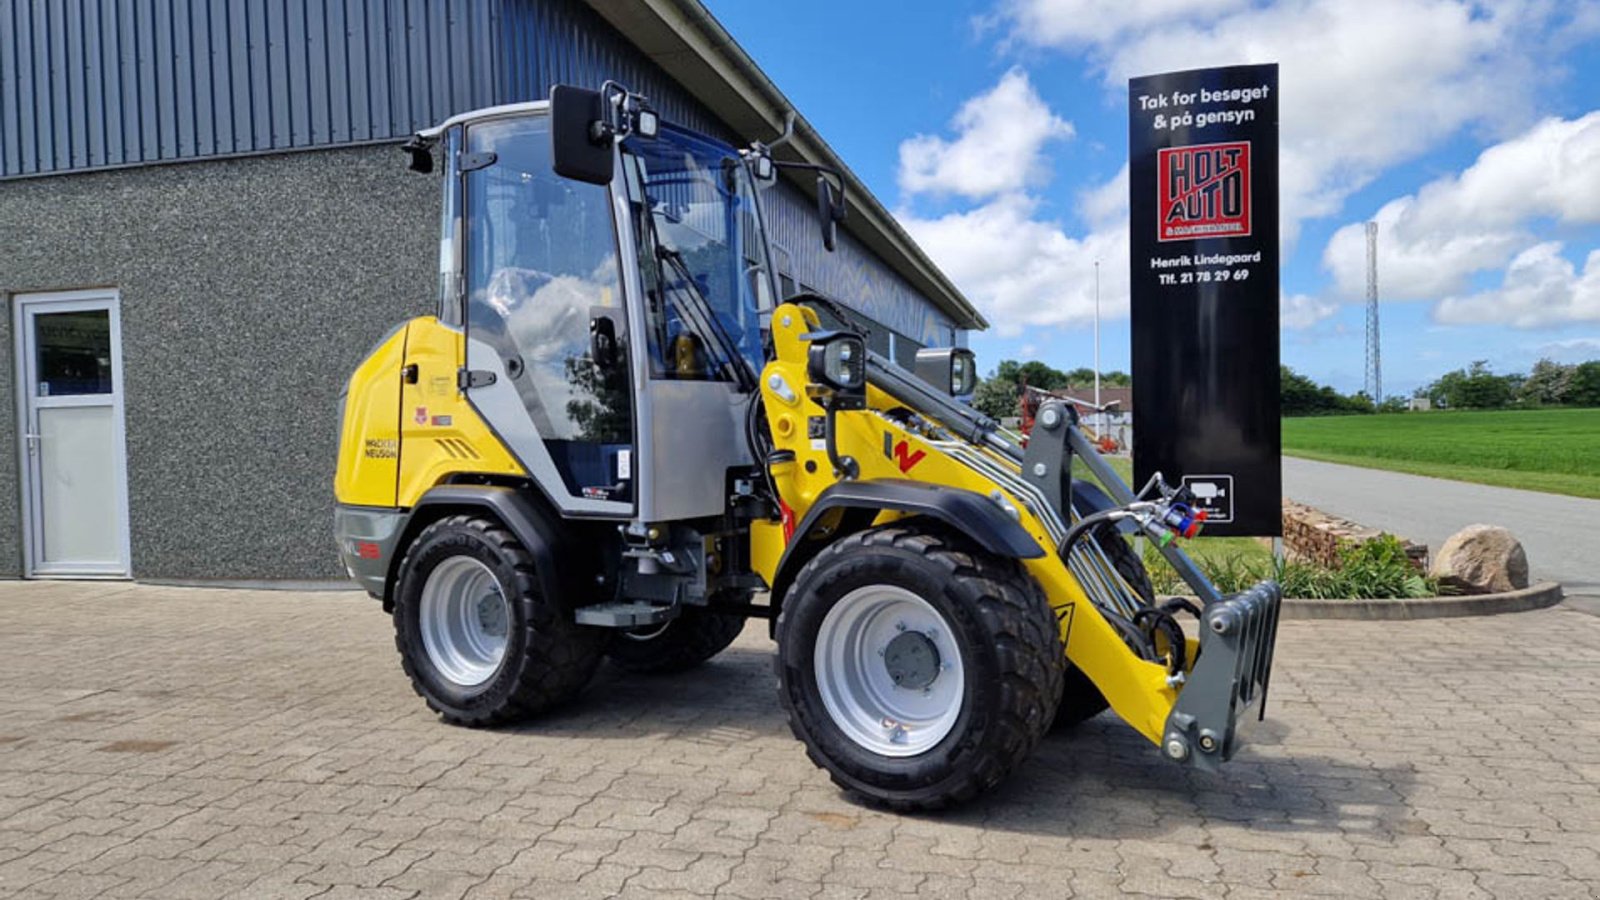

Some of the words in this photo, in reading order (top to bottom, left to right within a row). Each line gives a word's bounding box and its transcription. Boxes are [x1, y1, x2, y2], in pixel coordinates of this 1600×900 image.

[1139, 94, 1169, 110] Tak
[1172, 91, 1197, 106] for
[1200, 84, 1270, 103] besøget
[1153, 114, 1167, 130] &
[1170, 111, 1193, 130] på
[1195, 109, 1255, 128] gensyn
[1169, 148, 1242, 201] HOLT
[1166, 168, 1243, 223] AUTO
[1150, 255, 1191, 269] Henrik
[1194, 251, 1261, 266] Lindegaard
[1159, 273, 1178, 285] Tlf.
[1180, 272, 1194, 284] 21
[1196, 271, 1211, 282] 78
[1214, 270, 1230, 282] 29
[1233, 269, 1250, 281] 69
